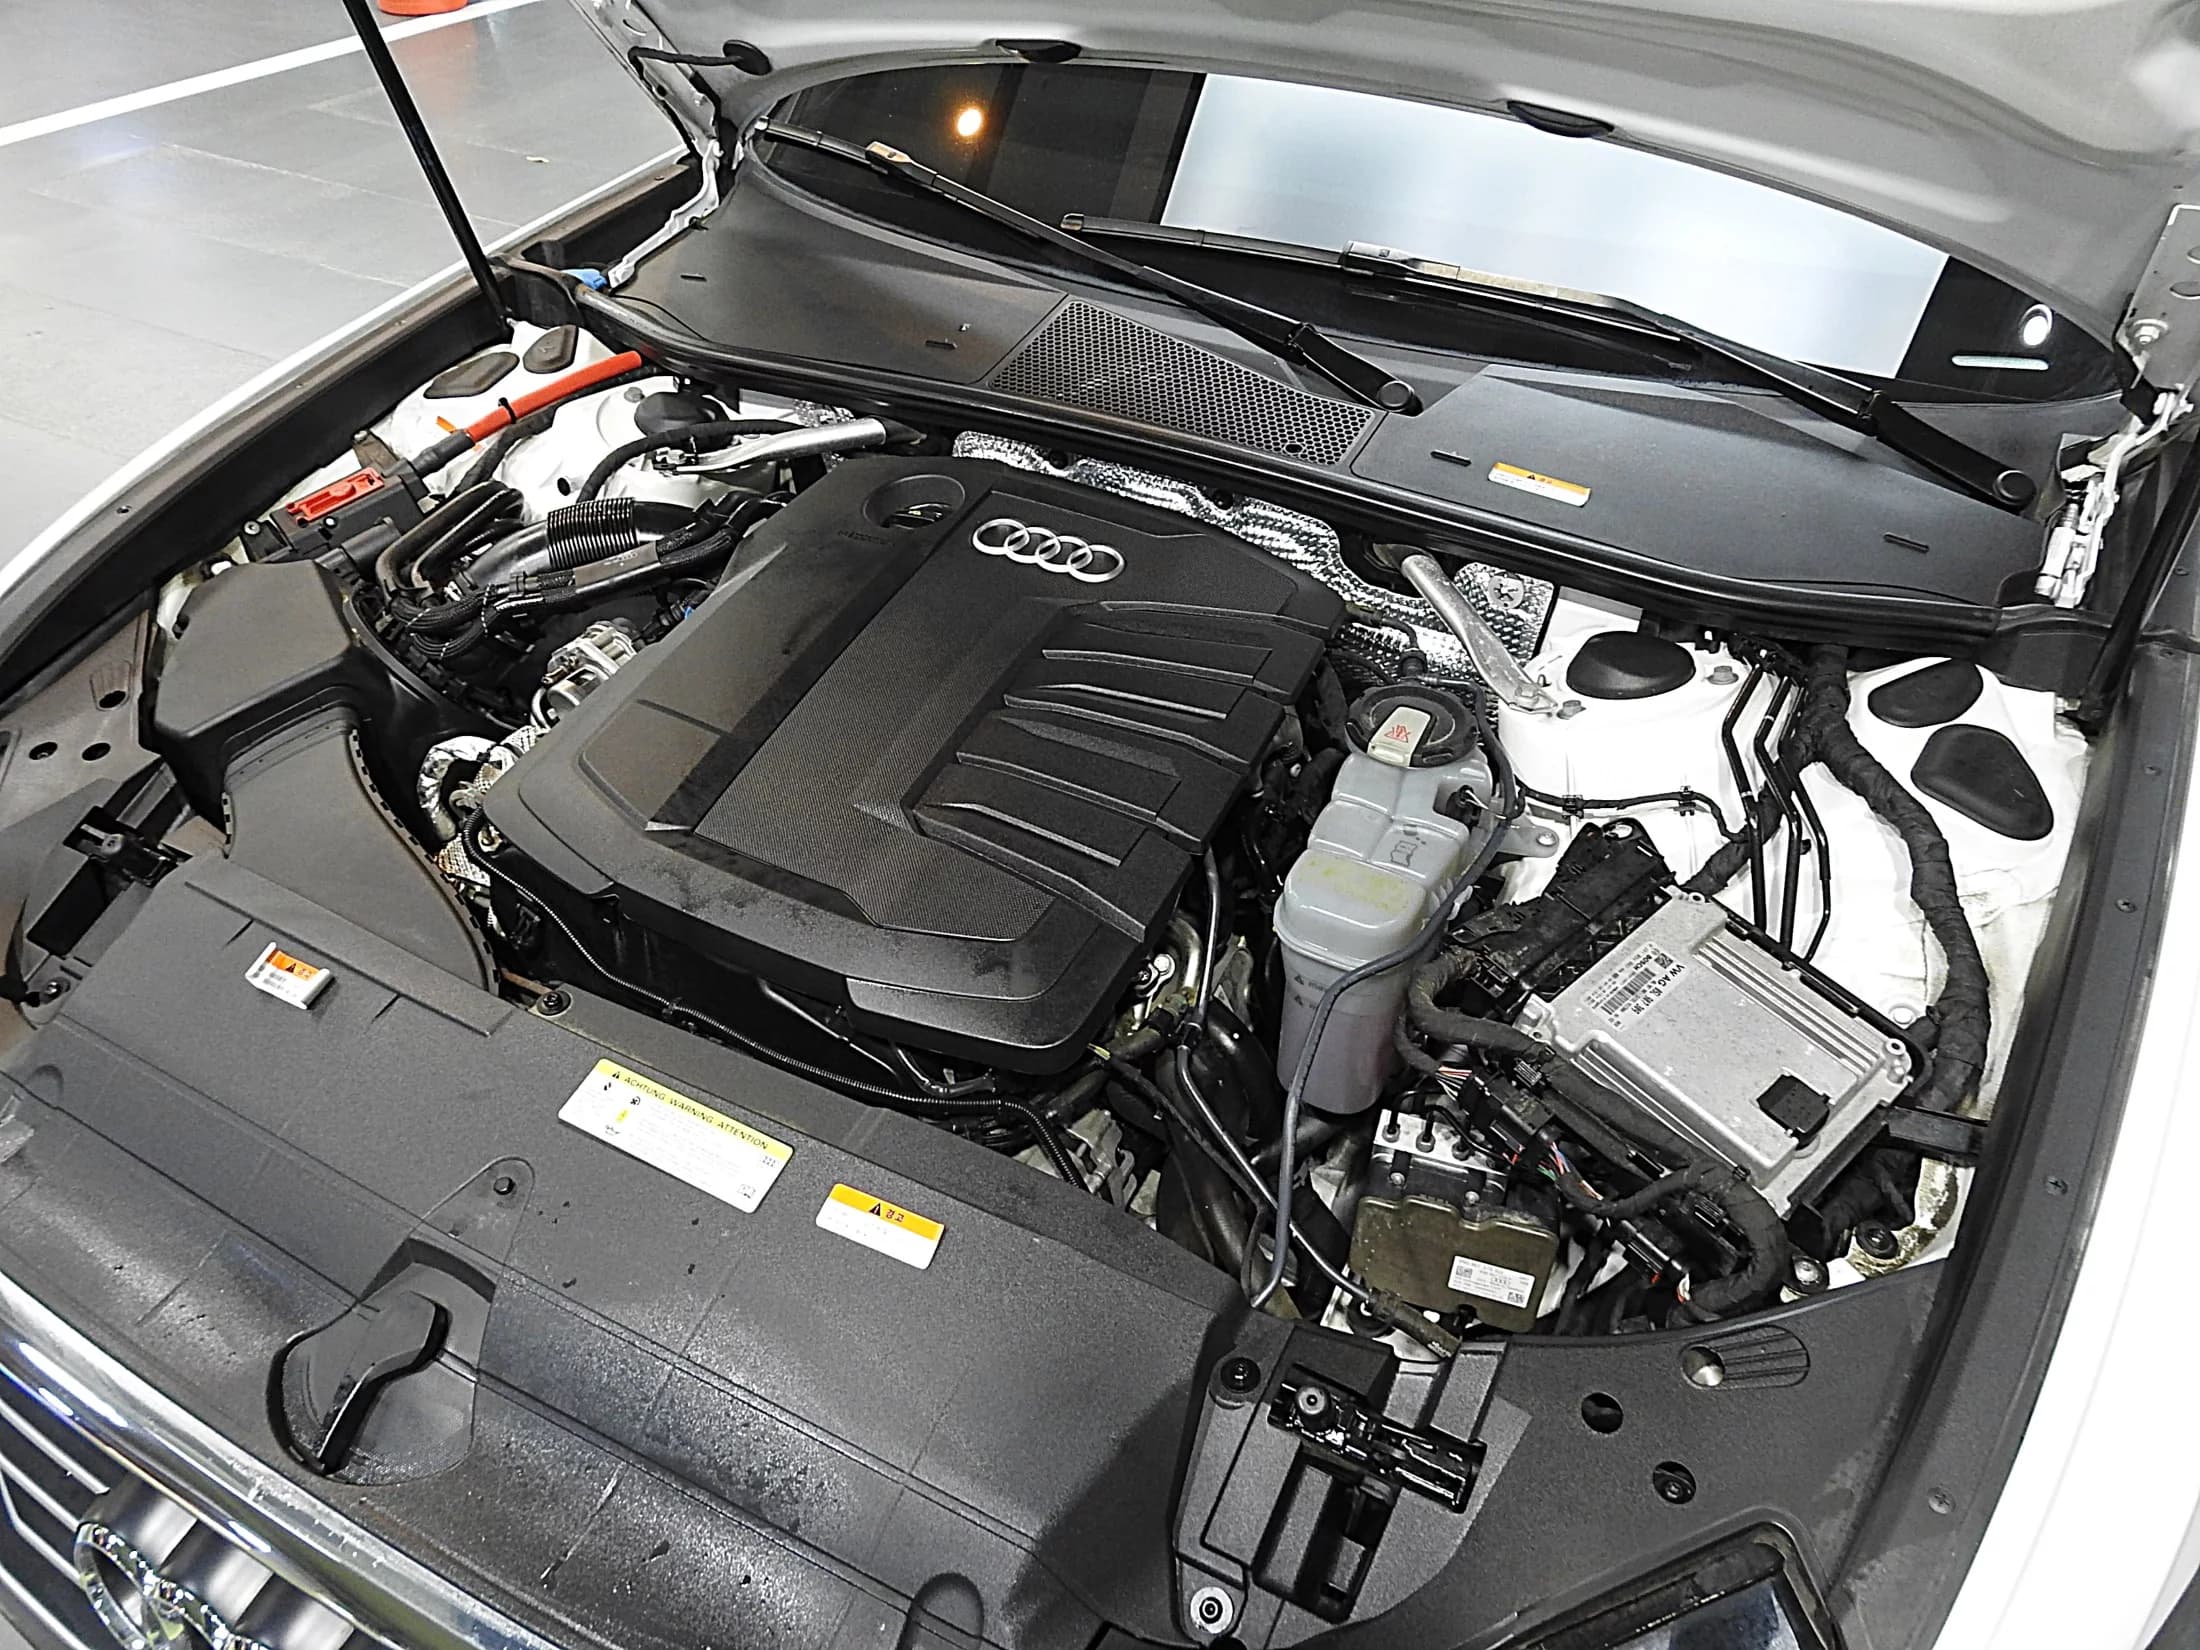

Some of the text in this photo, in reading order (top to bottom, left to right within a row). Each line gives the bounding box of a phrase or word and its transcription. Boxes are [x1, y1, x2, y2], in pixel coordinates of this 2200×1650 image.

[1633, 954, 1652, 971] BOSCH
[1669, 964, 1685, 977] VW
[1658, 974, 1671, 986] AG
[624, 1076, 769, 1150] ACHTUNG WARNING ATTENTION
